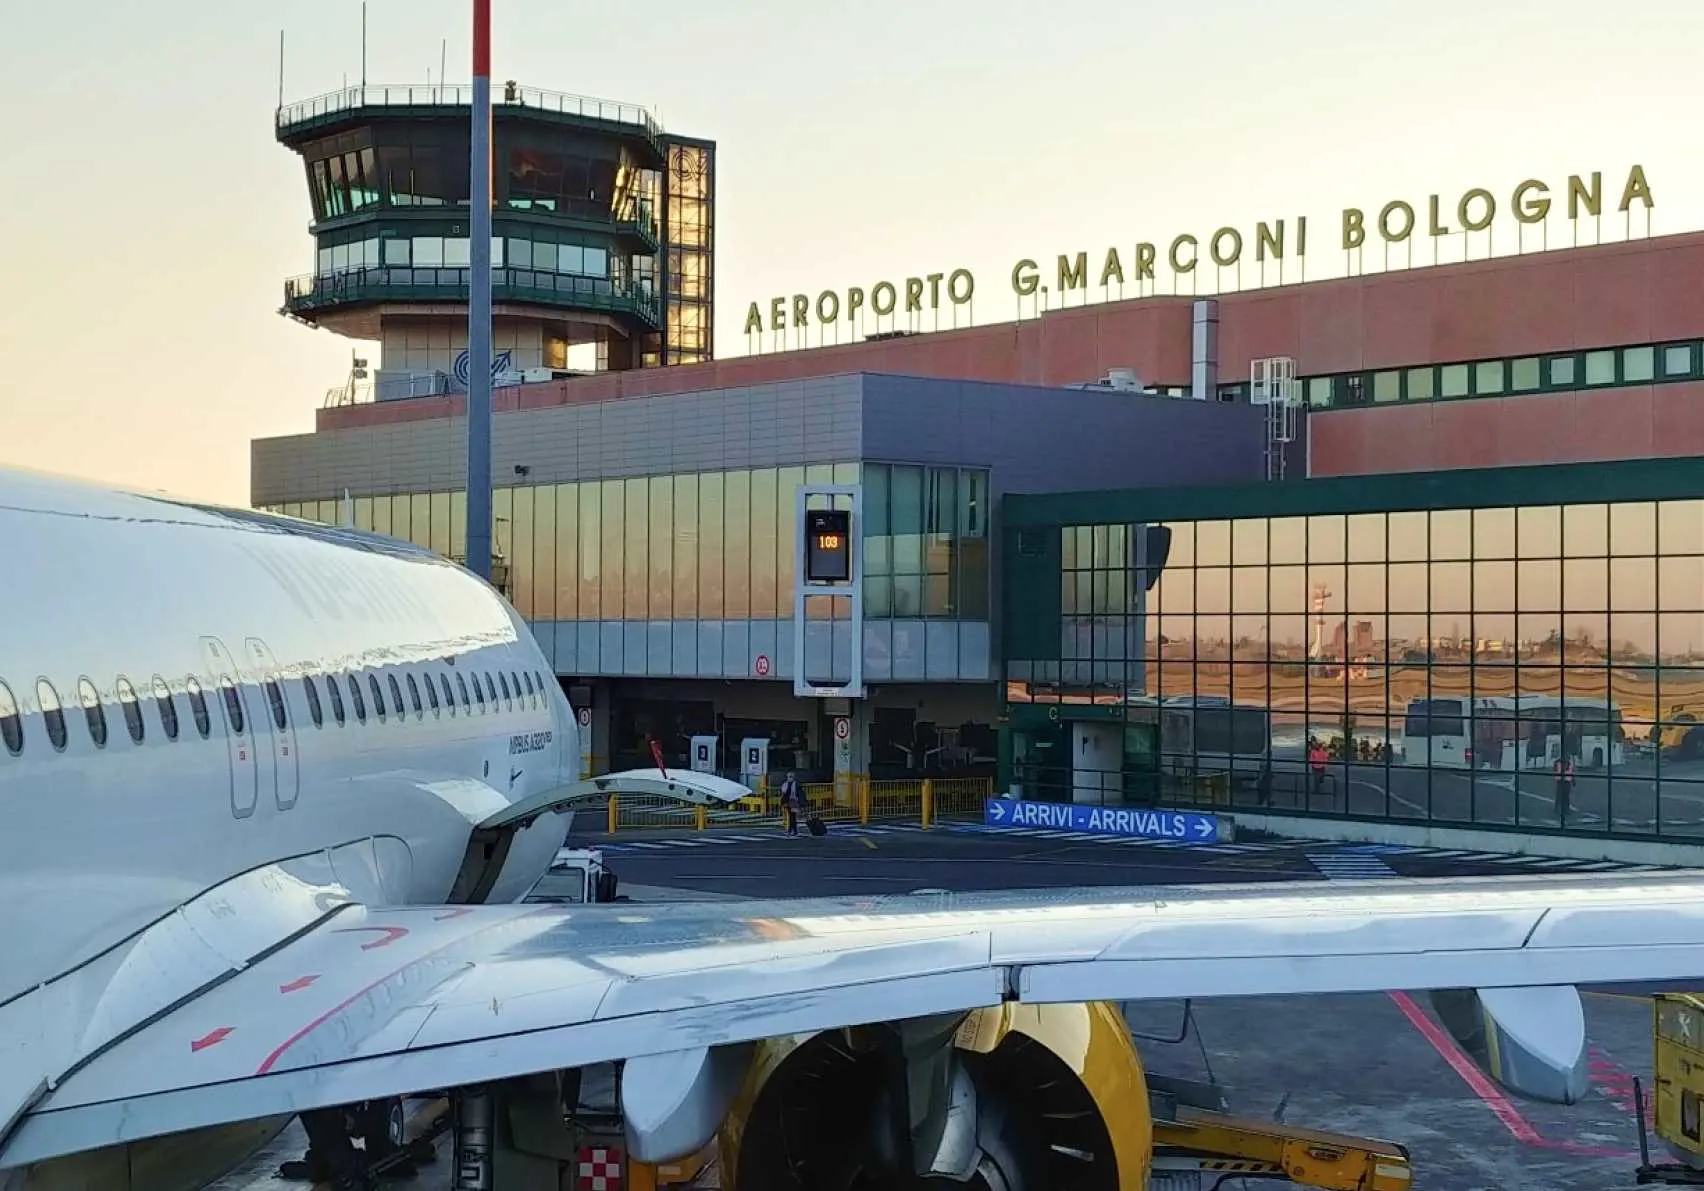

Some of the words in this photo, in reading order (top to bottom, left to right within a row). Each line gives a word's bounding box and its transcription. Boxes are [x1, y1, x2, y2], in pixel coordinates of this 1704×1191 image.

[746, 268, 975, 332] AEROPORTO
[1343, 164, 1656, 250] BOLOGNA
[820, 535, 838, 549] 103
[1012, 804, 1073, 827] ARRIVI
[1089, 810, 1185, 836] ARRIVALS
